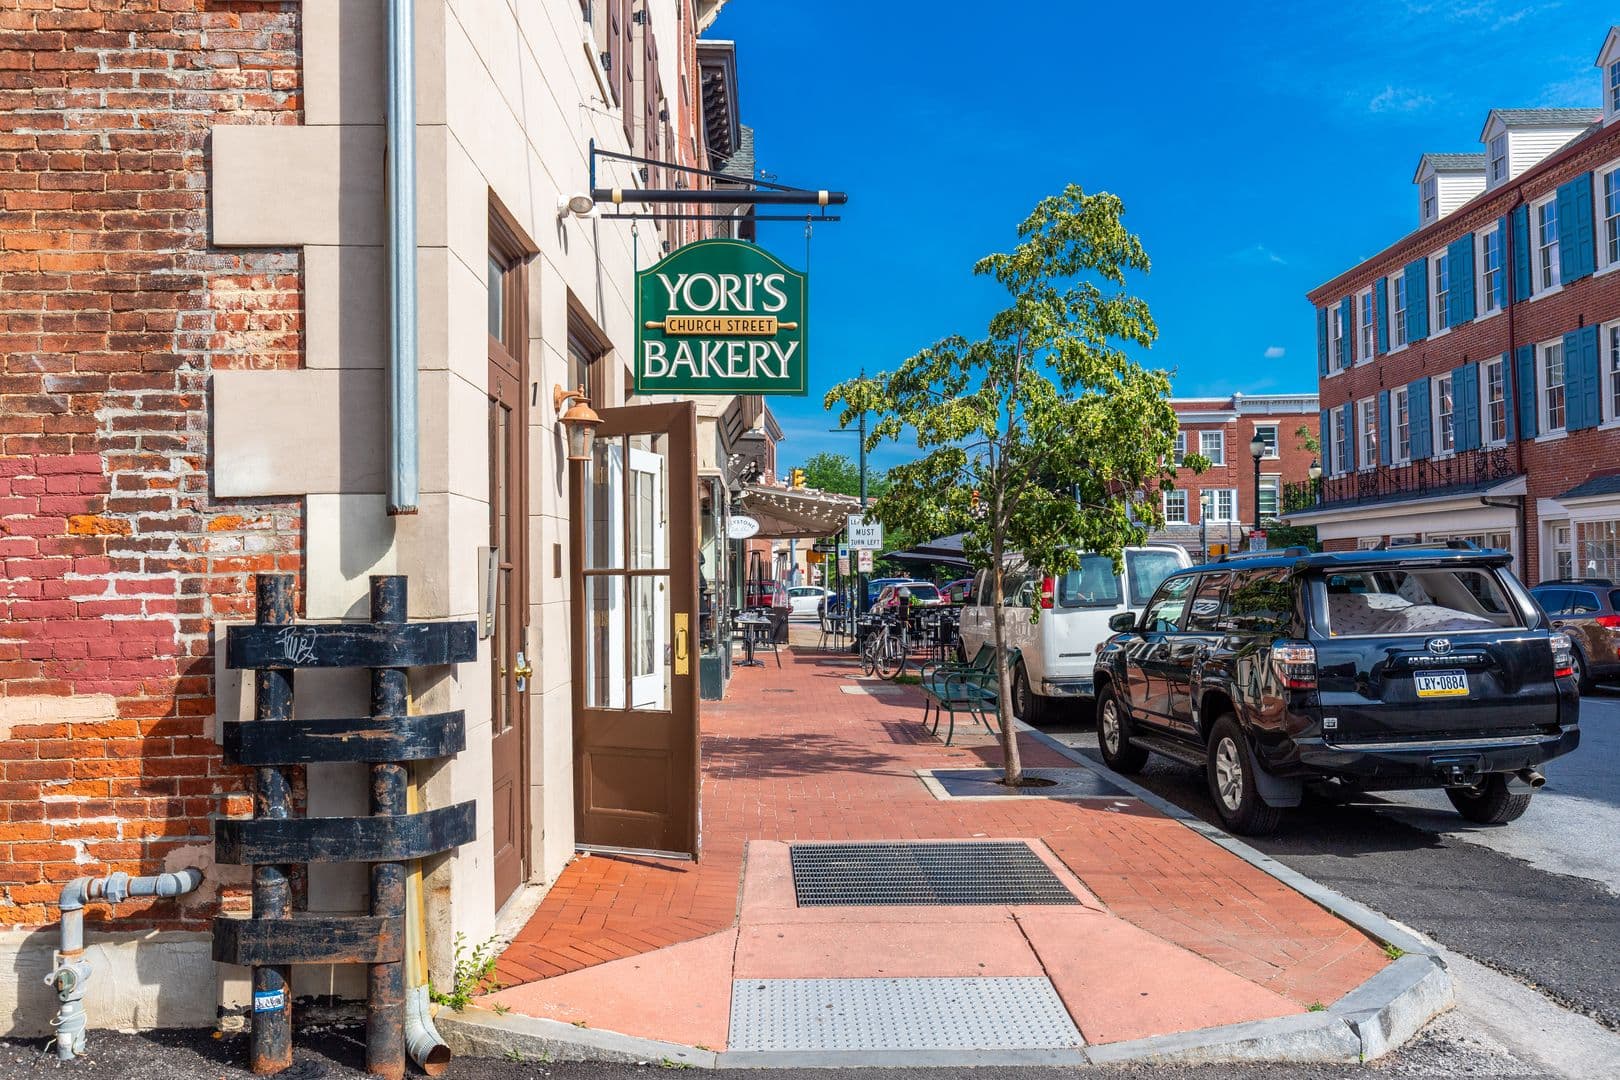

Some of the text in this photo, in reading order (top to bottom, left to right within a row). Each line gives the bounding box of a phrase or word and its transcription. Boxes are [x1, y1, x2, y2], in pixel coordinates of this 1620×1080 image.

[657, 273, 788, 312] YORI'S
[669, 319, 773, 332] CHURCH STREET
[643, 341, 799, 378] BAKERY
